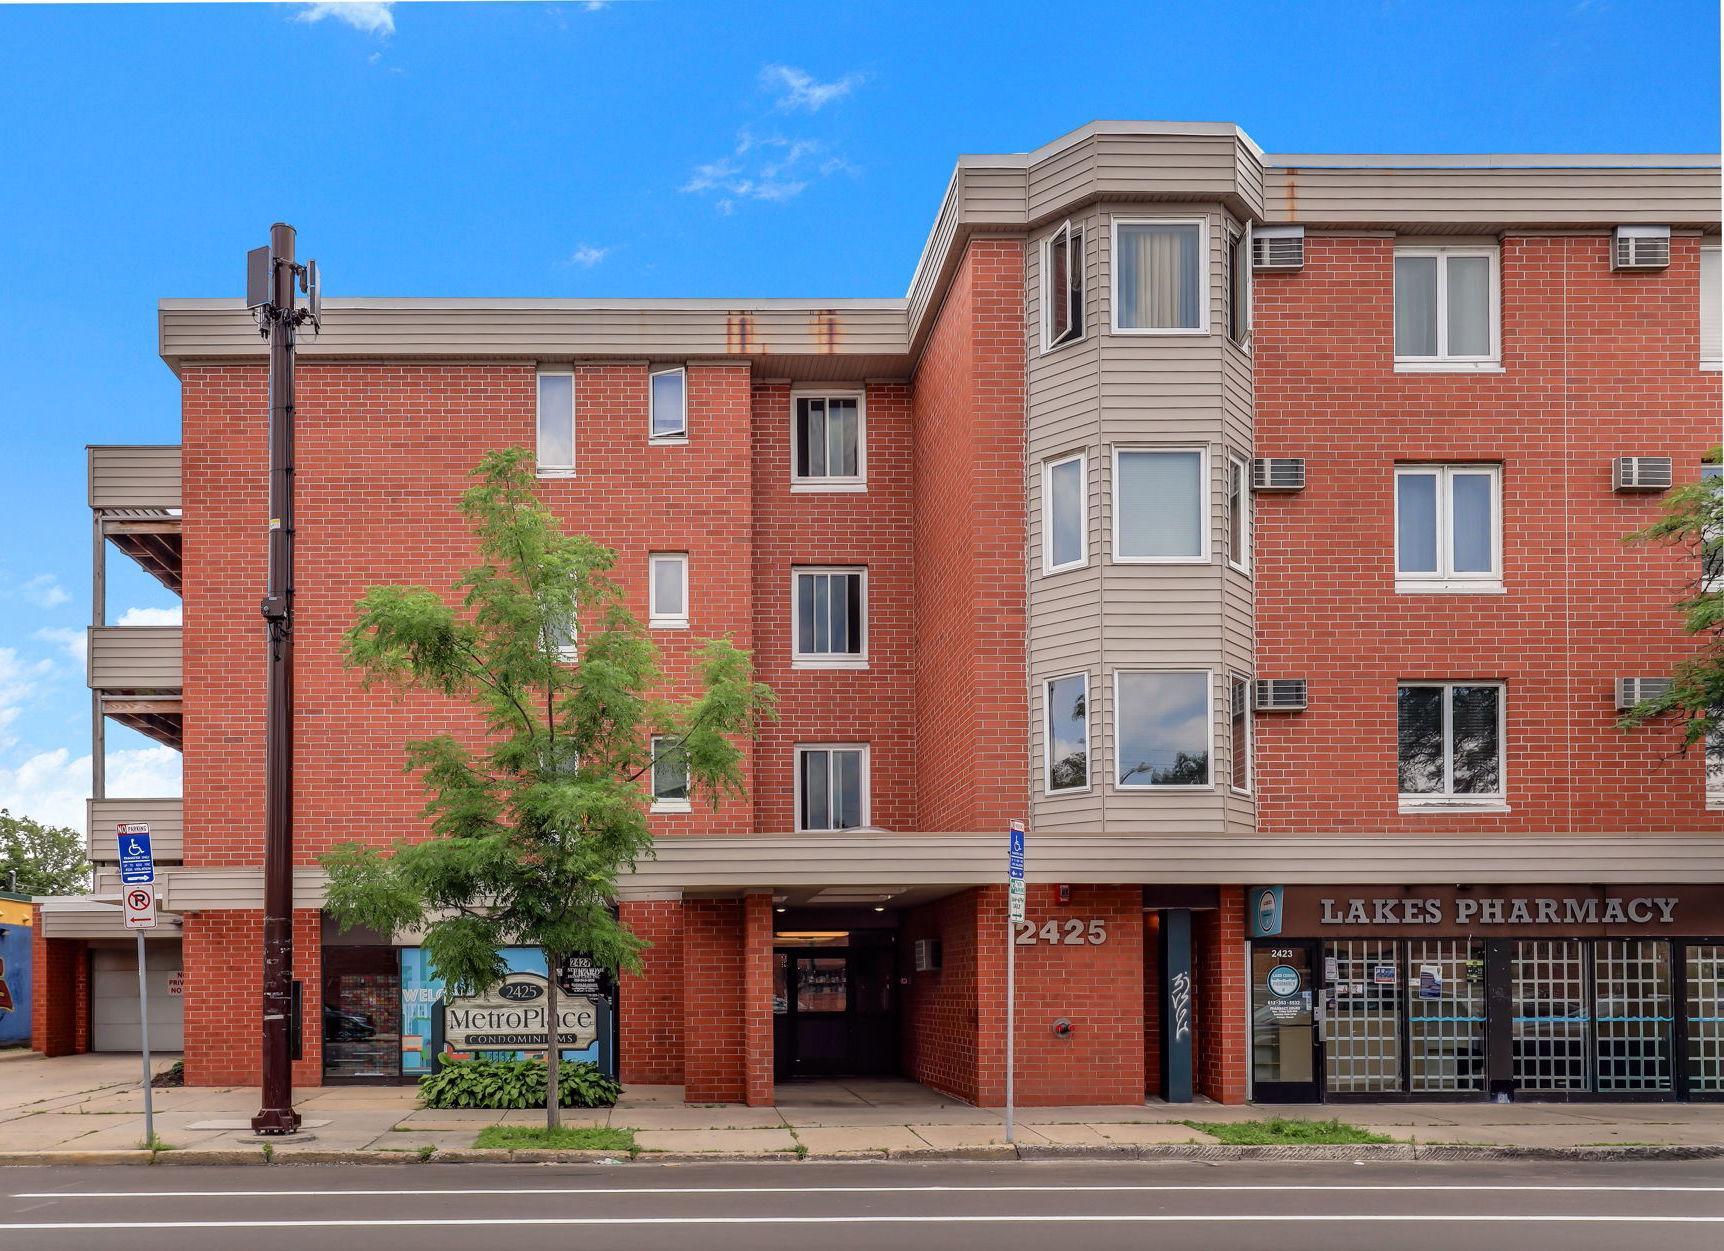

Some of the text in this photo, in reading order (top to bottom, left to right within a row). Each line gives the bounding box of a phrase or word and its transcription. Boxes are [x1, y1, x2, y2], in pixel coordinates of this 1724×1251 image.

[117, 824, 127, 834] NO
[1320, 897, 1679, 924] LAKES PHARMACY
[1015, 919, 1107, 945] 2425
[1271, 949, 1293, 958] 2423
[505, 985, 537, 999] 2425
[449, 1007, 593, 1030] MetroPlce
[469, 1034, 574, 1044] CONDOMINIMS
